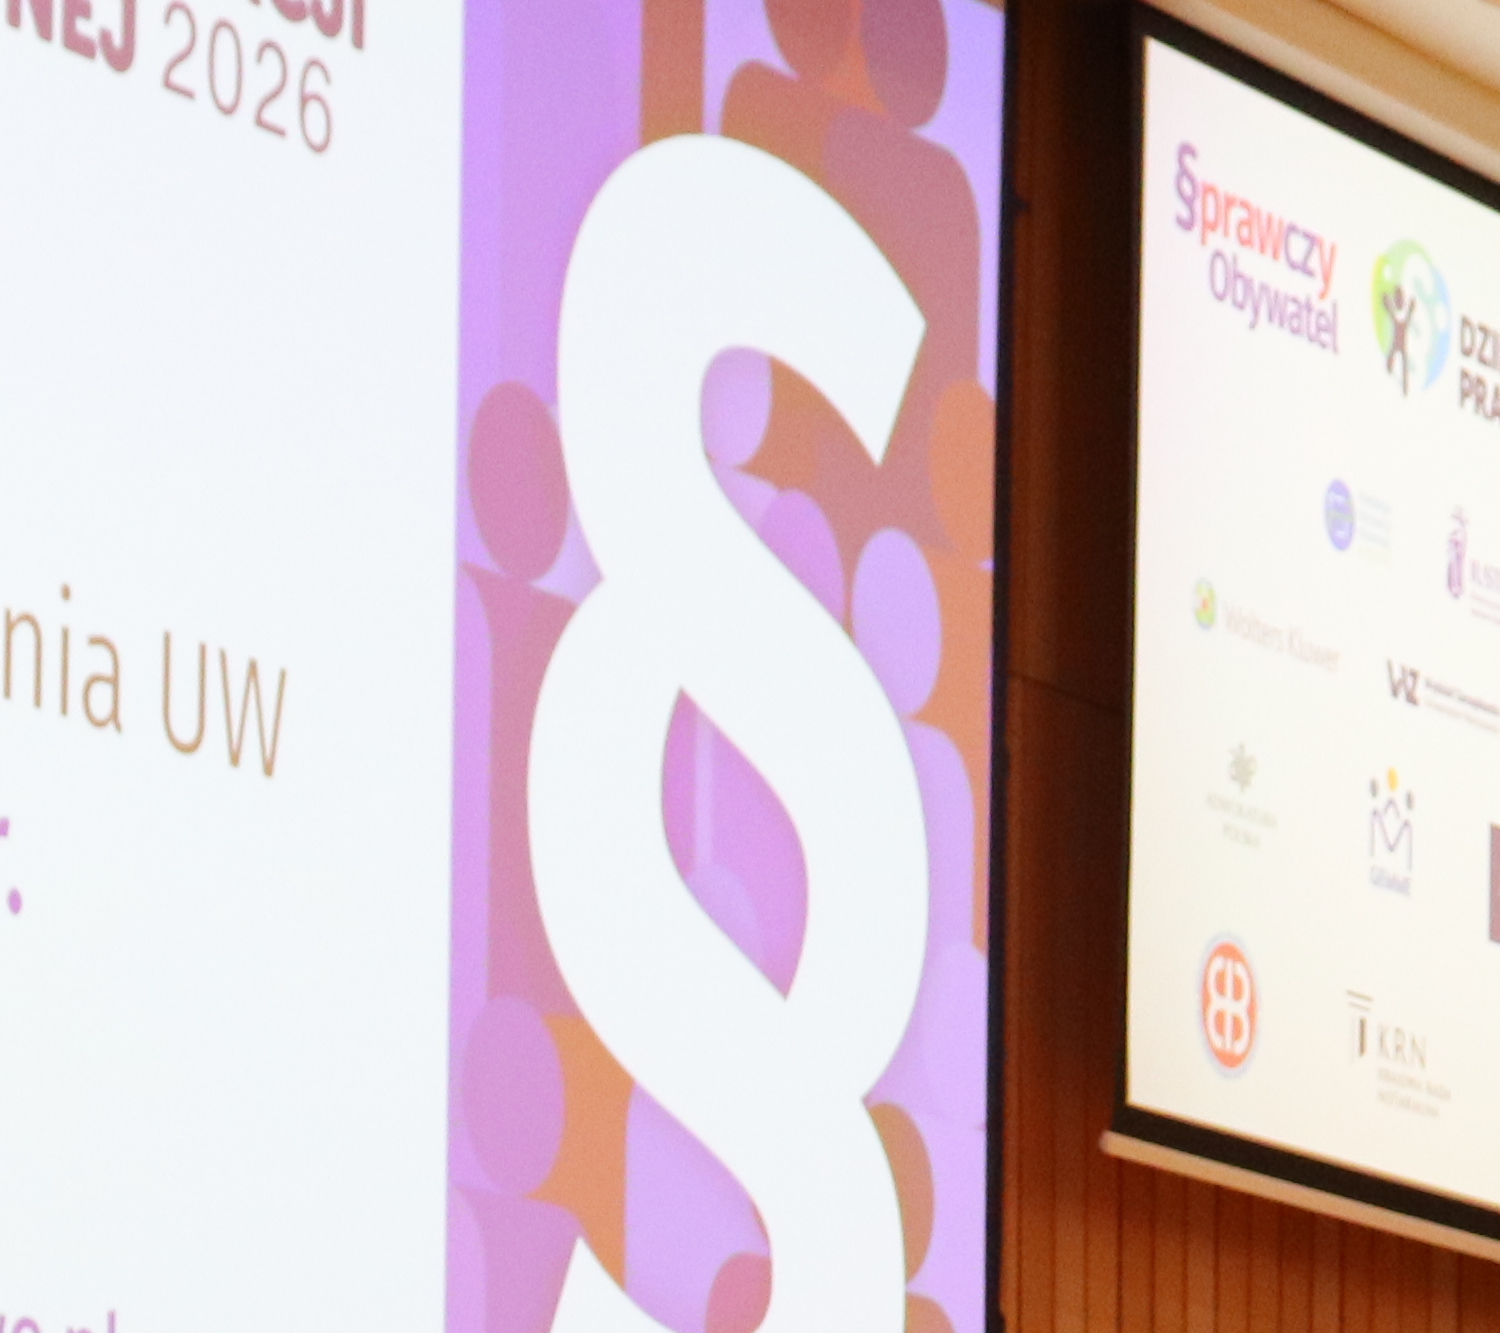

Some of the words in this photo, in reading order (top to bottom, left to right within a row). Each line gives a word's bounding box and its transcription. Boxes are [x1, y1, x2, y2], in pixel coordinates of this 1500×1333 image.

[161, 2, 333, 155] 2026
[1210, 250, 1339, 354] Obywatel
[161, 631, 287, 779] UW
[1386, 657, 1421, 706] WZ
[1378, 1023, 1428, 1069] KRN
